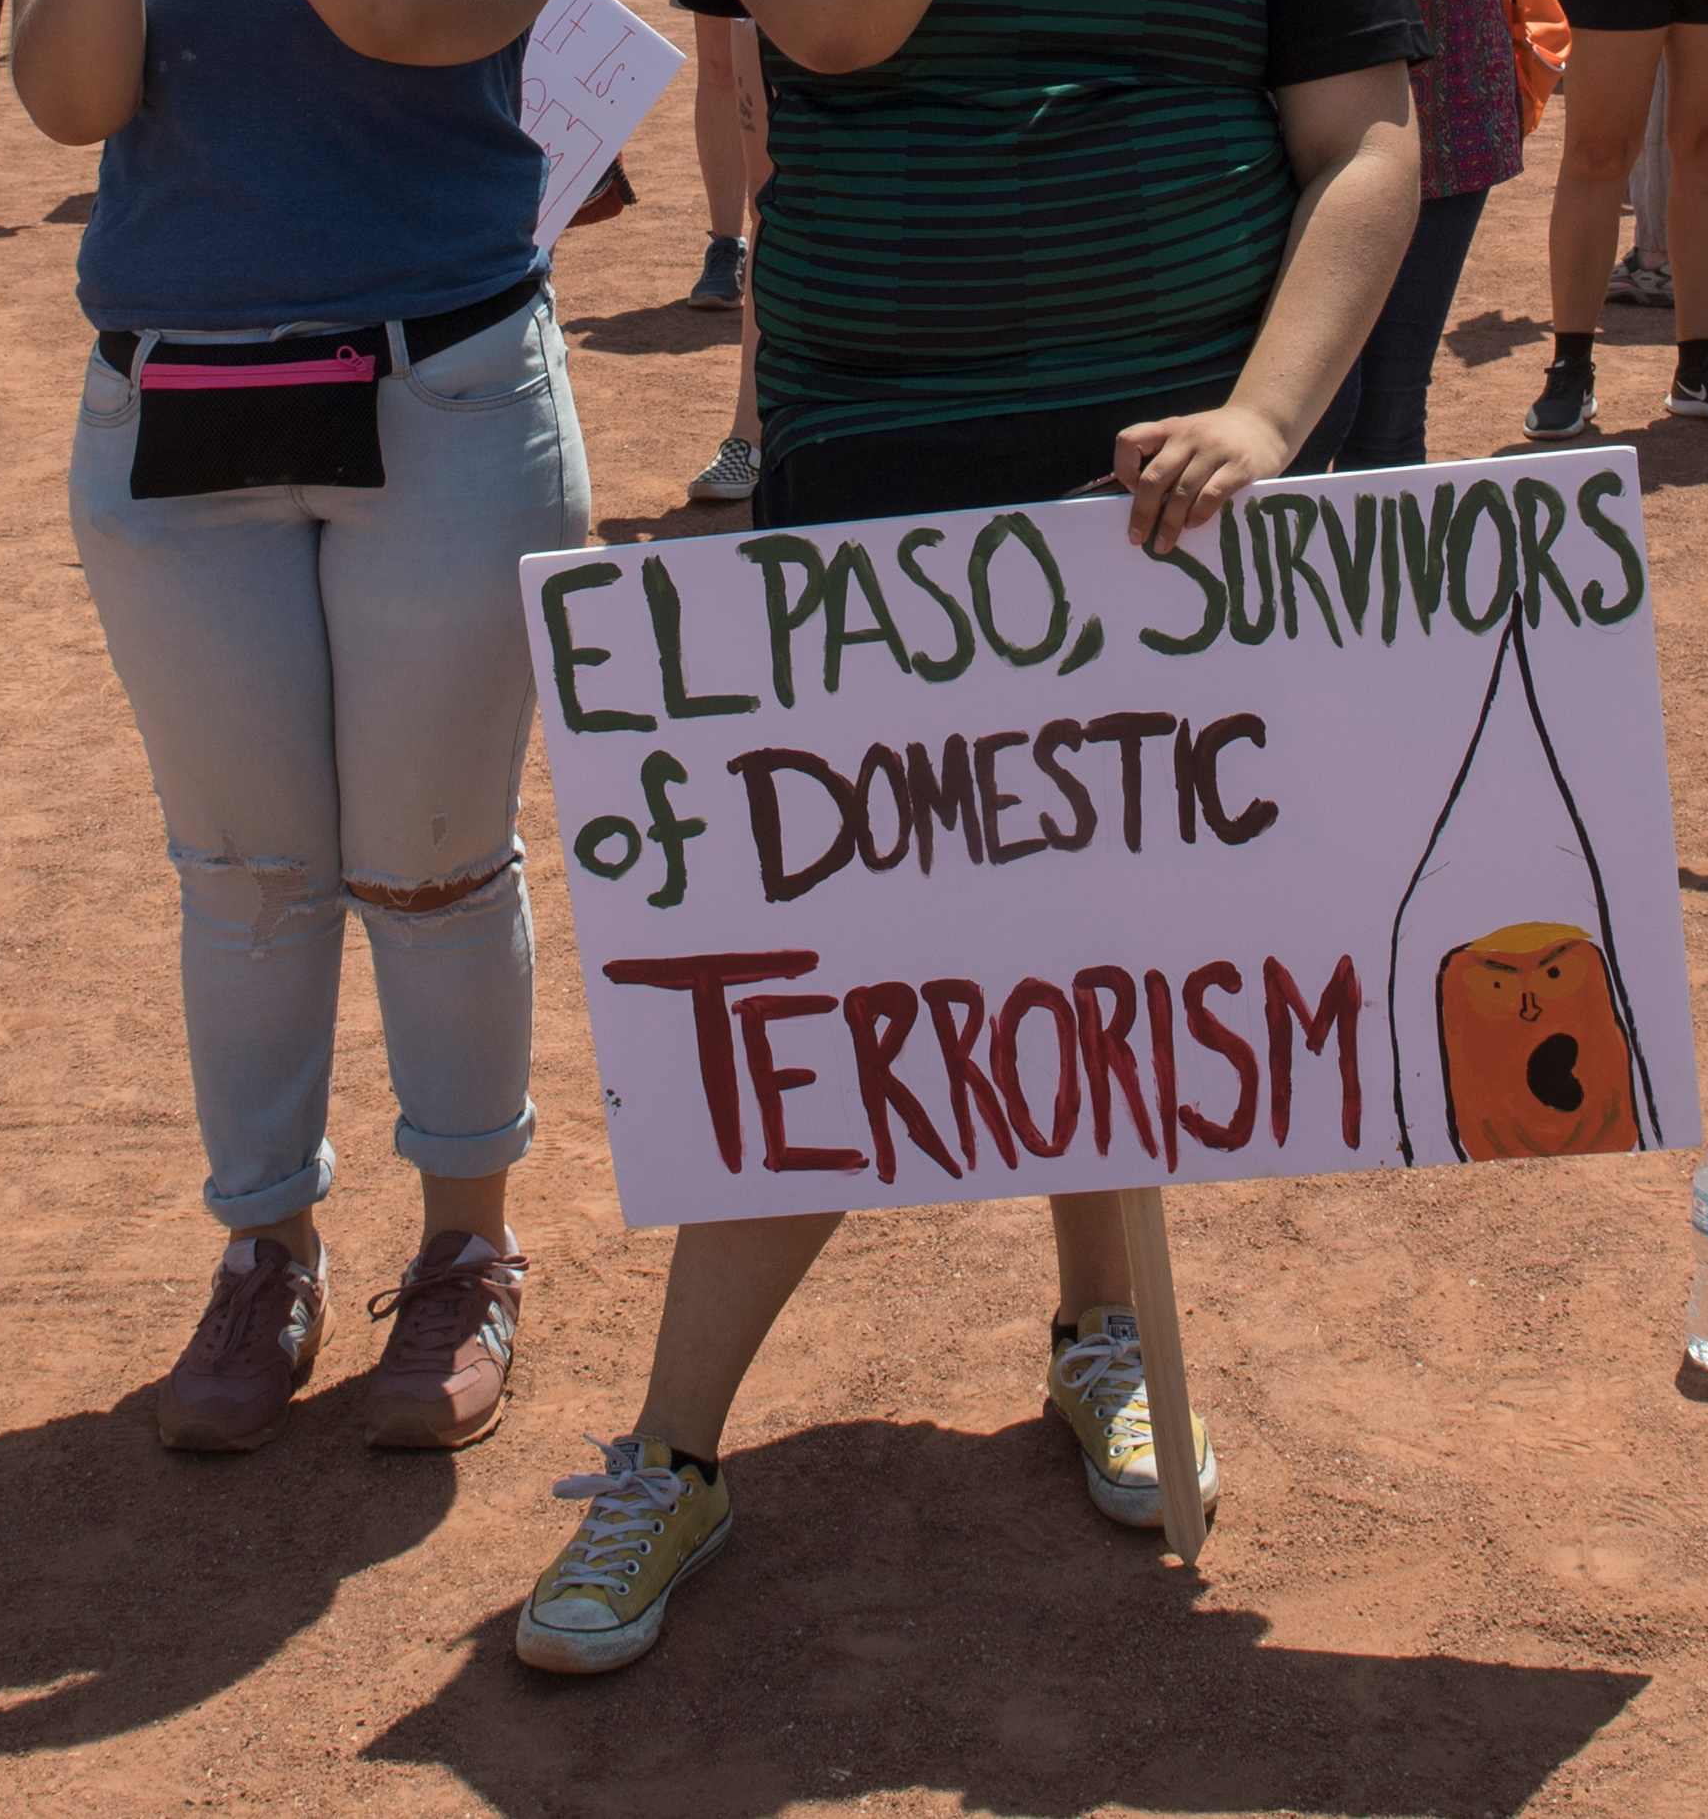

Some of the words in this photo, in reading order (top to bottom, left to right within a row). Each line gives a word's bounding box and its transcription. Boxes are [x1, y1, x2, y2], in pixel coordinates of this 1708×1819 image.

[541, 555, 760, 734] EL
[738, 512, 1103, 709] PASO,
[1139, 470, 1644, 655] SURVIVORS
[574, 750, 707, 907] of
[727, 711, 1278, 903] DOMESTIC
[602, 949, 1363, 1183] TERRORISM
